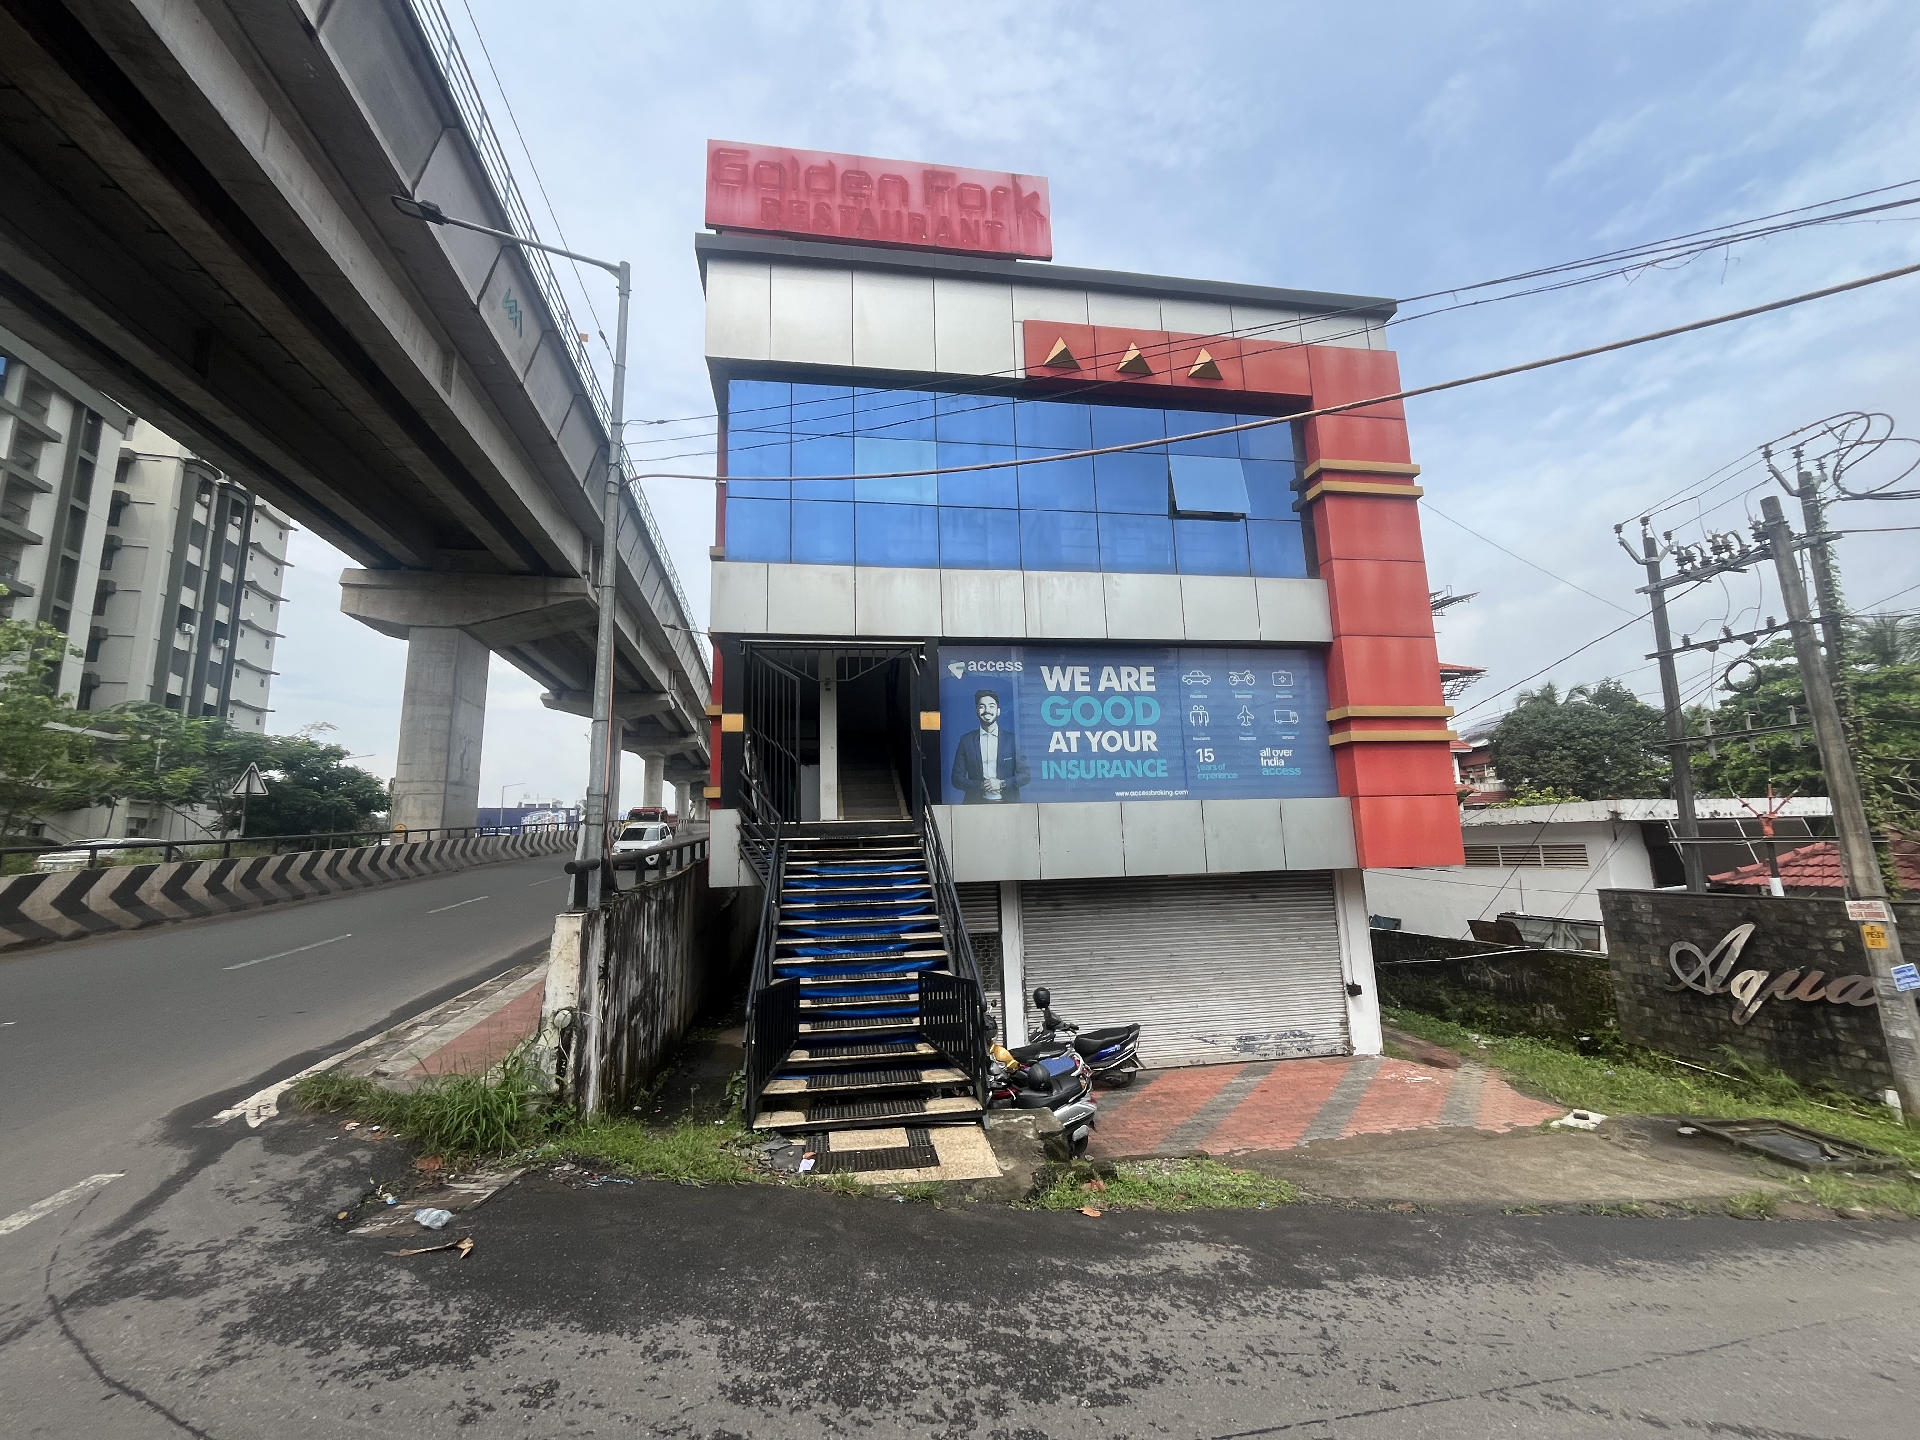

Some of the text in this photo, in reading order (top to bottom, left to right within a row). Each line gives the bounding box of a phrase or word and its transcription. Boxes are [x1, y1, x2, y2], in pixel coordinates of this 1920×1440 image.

[711, 147, 1046, 224] Golden Fork
[760, 197, 1004, 244] RESTAURANT
[967, 659, 1023, 672] access
[1040, 665, 1156, 692] WE ARE
[1041, 695, 1161, 727] GOOD
[1048, 730, 1158, 753] AT YOUR
[1260, 747, 1293, 757] all over
[1195, 748, 1215, 763] 15
[1260, 757, 1285, 767] India
[1041, 758, 1169, 780] INSURANCE
[1261, 767, 1302, 776] access
[1663, 923, 1877, 1026] Aqua
